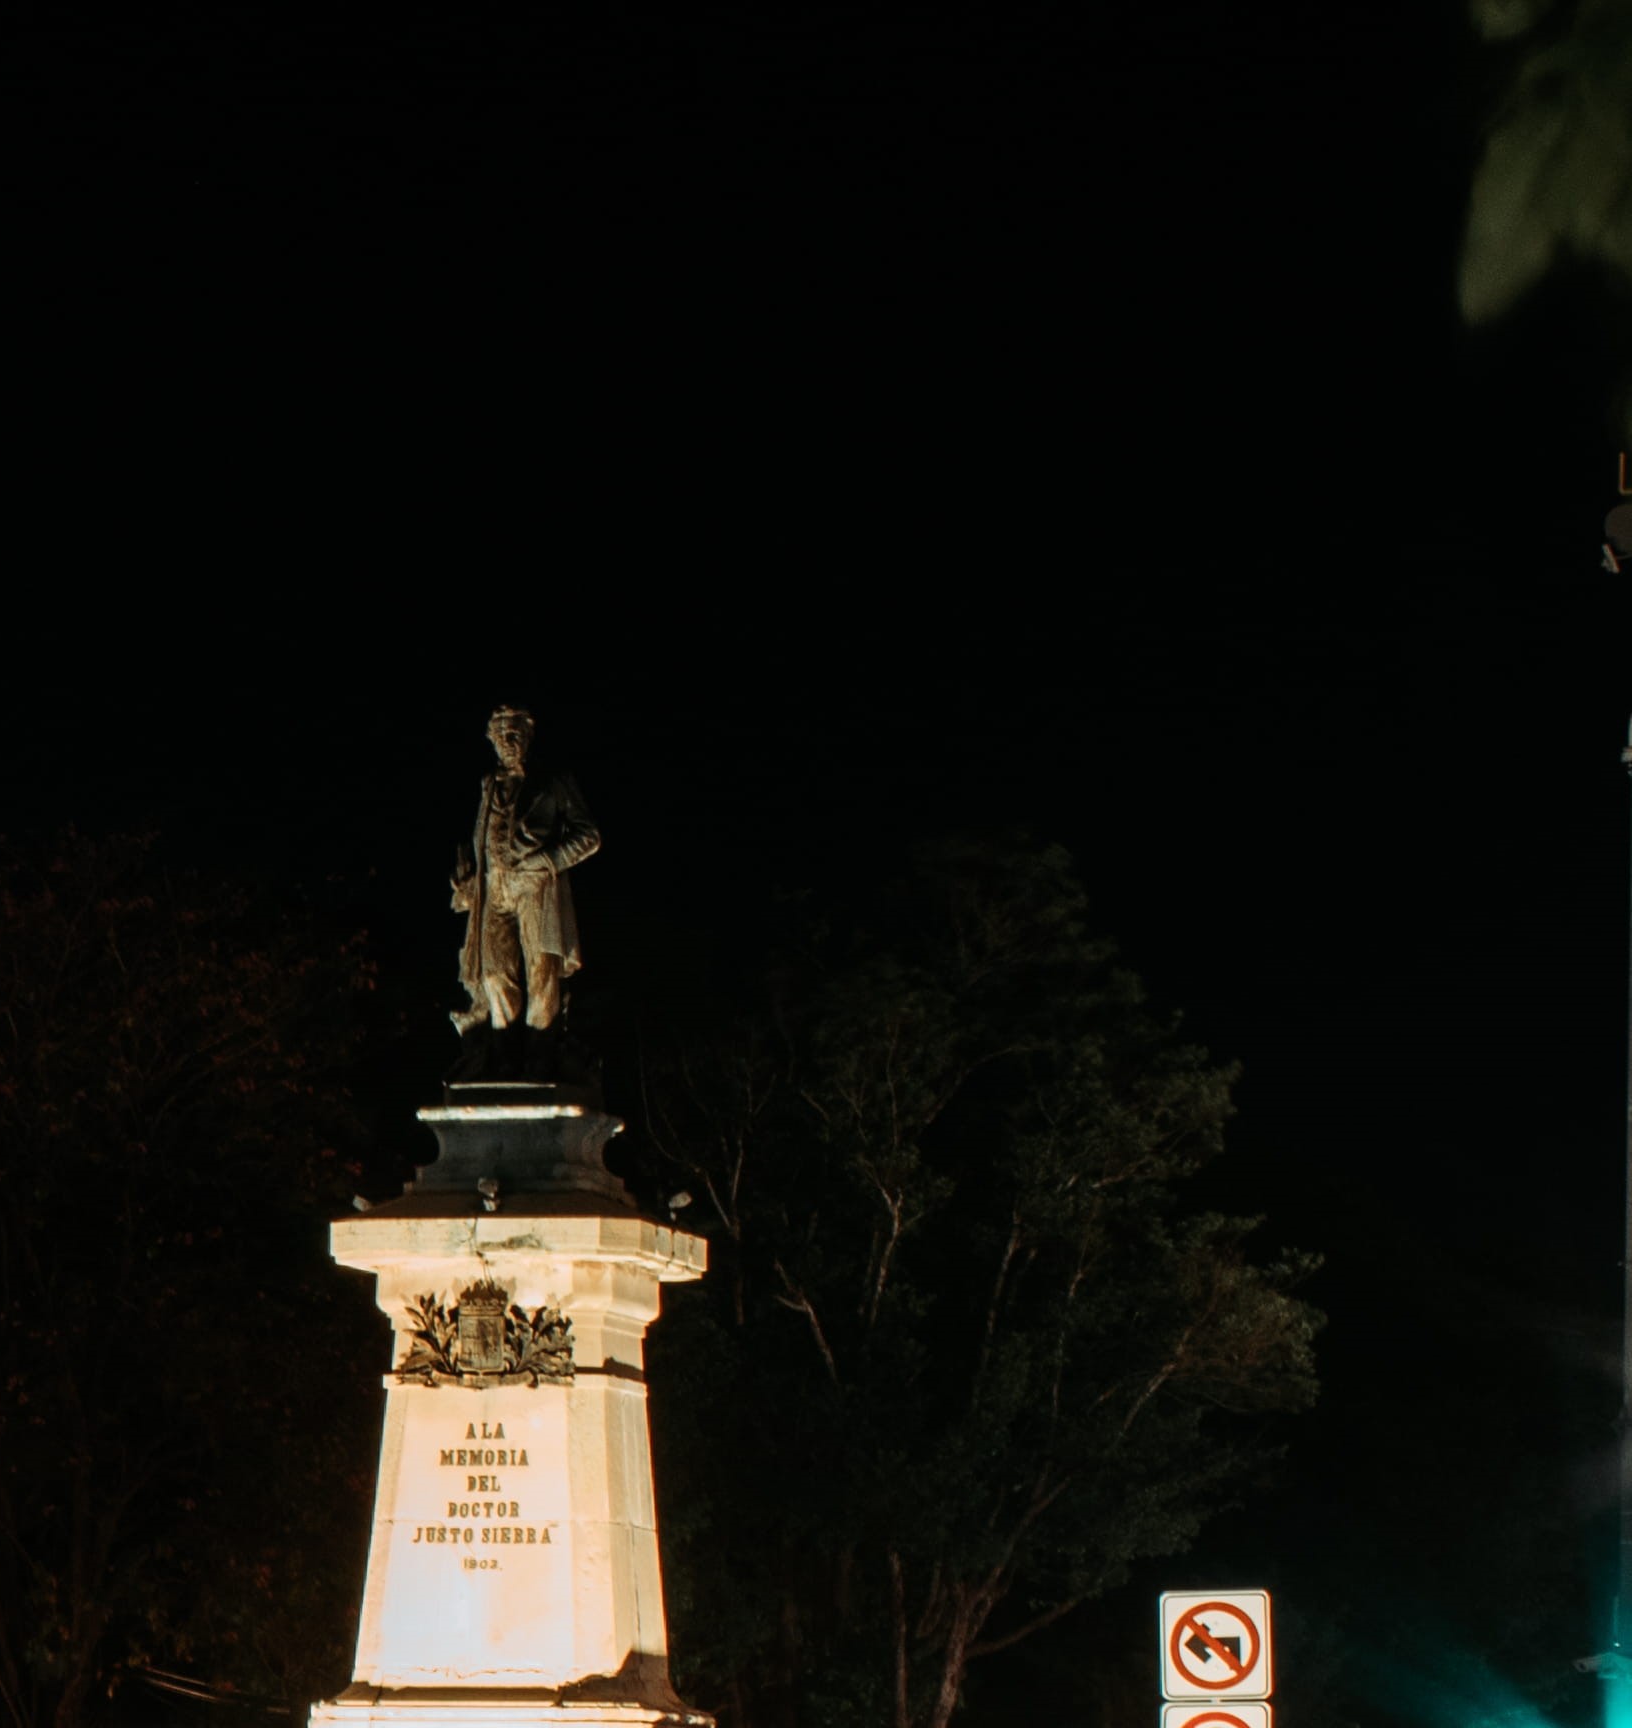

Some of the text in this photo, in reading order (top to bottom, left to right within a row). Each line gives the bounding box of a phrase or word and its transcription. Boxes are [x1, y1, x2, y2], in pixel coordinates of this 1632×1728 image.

[465, 1422, 505, 1440] A LA
[439, 1449, 529, 1467] MEMORIA
[467, 1475, 501, 1493] DEL
[447, 1501, 520, 1518] DOCTOR
[413, 1527, 552, 1544] JUSTO SIERRA
